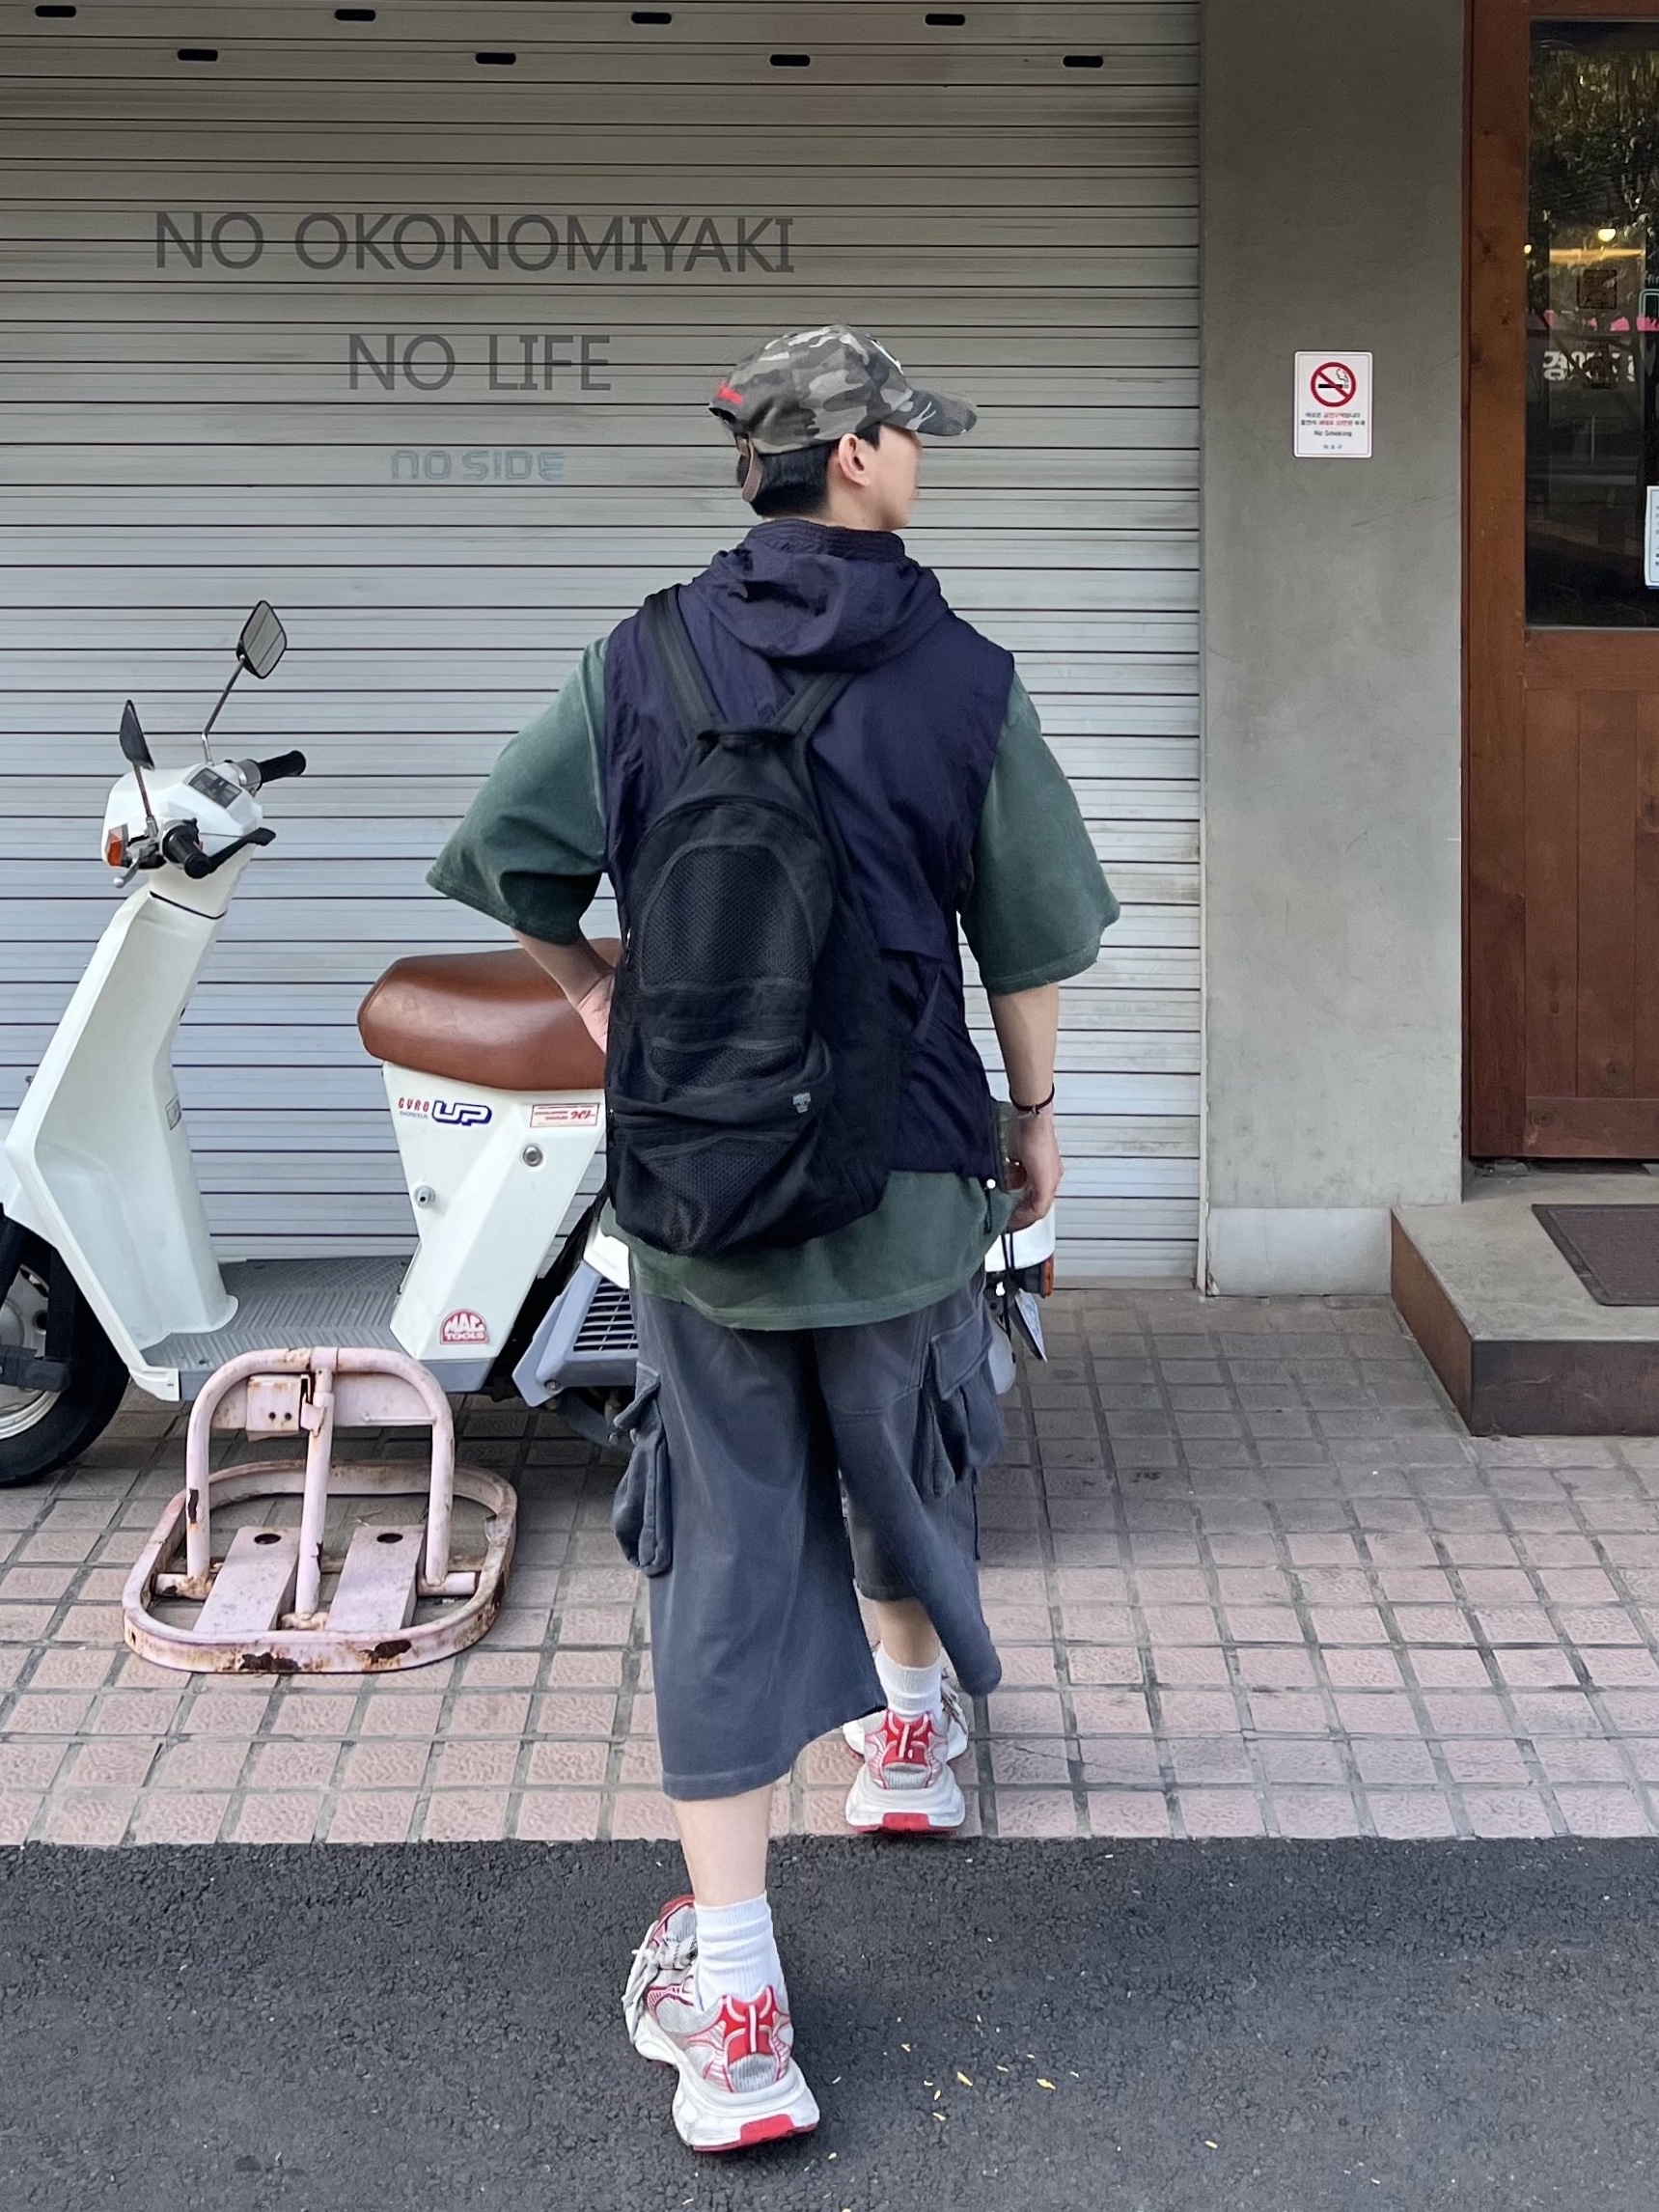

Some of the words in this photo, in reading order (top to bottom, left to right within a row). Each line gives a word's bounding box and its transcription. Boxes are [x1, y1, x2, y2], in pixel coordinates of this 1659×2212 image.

[155, 211, 265, 269] NO
[294, 213, 795, 273] OKONOMIYAKI
[348, 333, 456, 391] NO
[488, 334, 612, 391] LIFE
[461, 450, 567, 482] SIDE
[431, 1100, 492, 1126] UP
[444, 1313, 485, 1333] MAC
